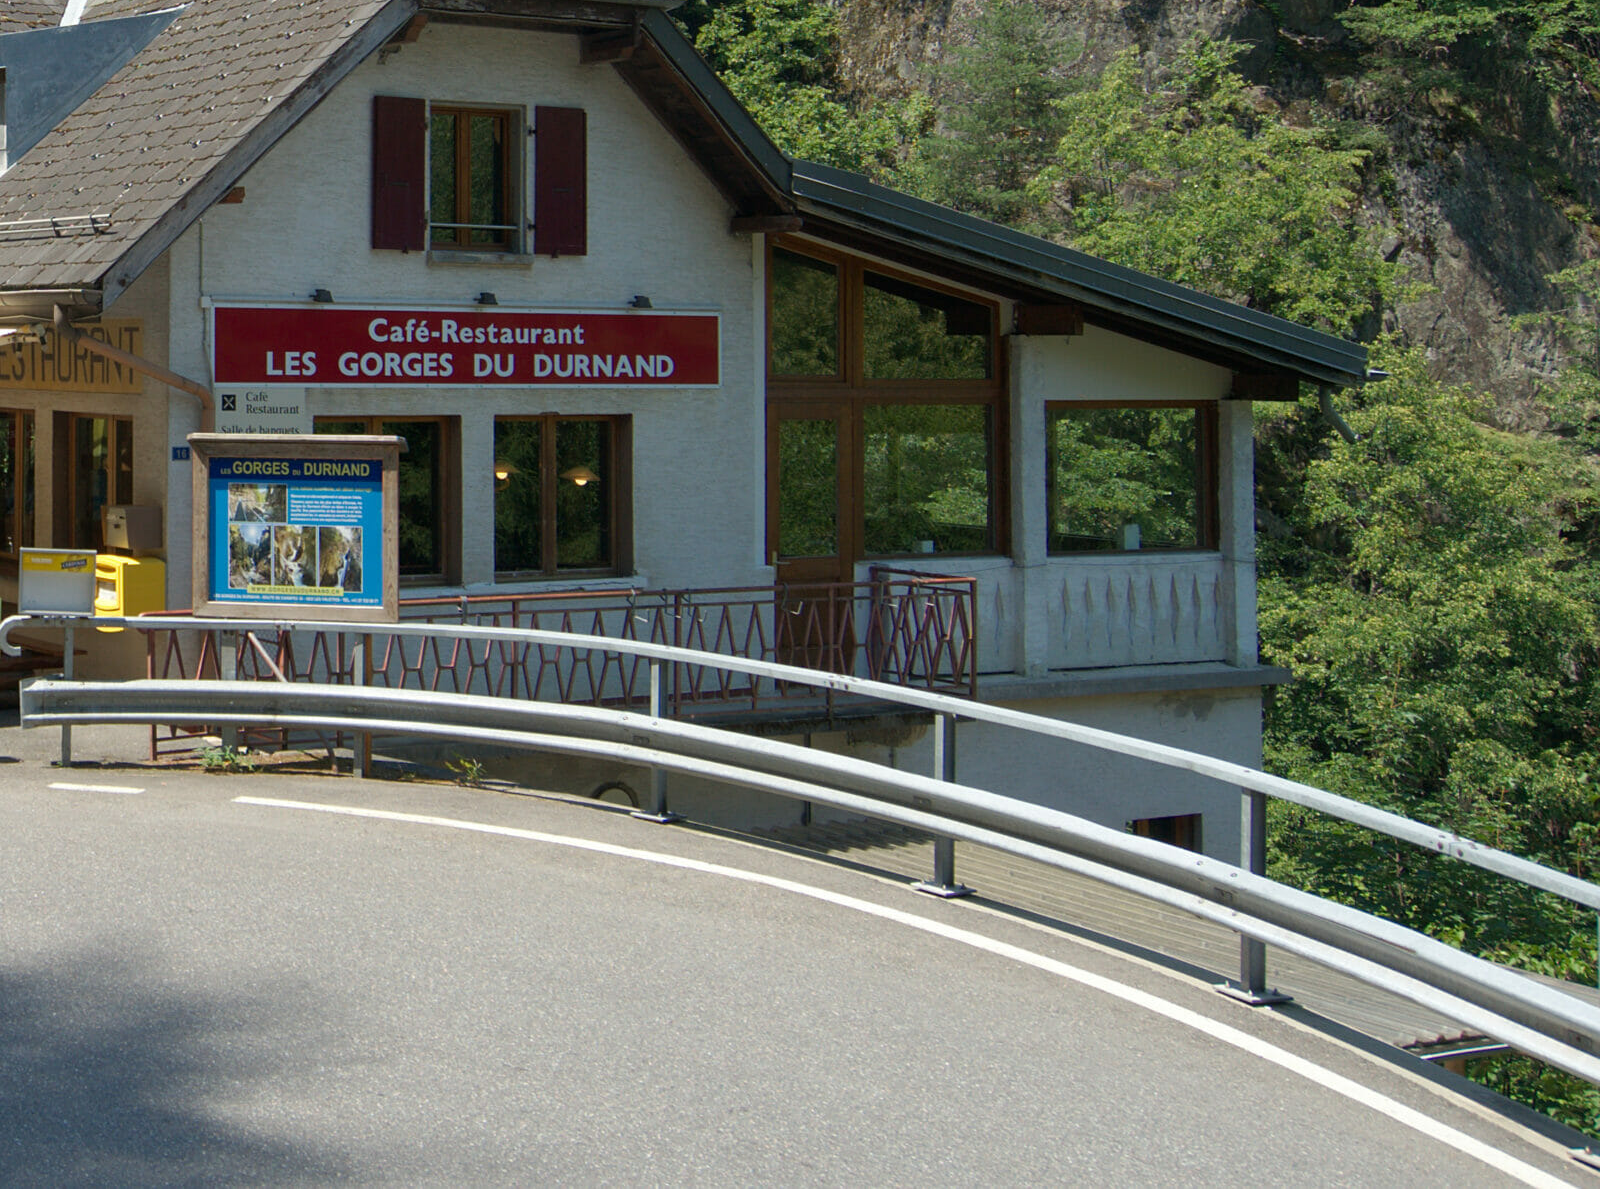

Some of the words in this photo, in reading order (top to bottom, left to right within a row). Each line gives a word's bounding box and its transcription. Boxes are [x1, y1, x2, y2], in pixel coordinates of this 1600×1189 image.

[368, 318, 584, 345] Café-Restaurant
[266, 350, 316, 377] LES
[338, 351, 454, 377] GORGES
[473, 353, 515, 378] DU
[534, 354, 675, 379] DURNAND
[246, 404, 299, 415] Restaurant
[176, 449, 187, 459] 16
[232, 461, 290, 475] GORGES
[303, 462, 370, 477] DURNAND
